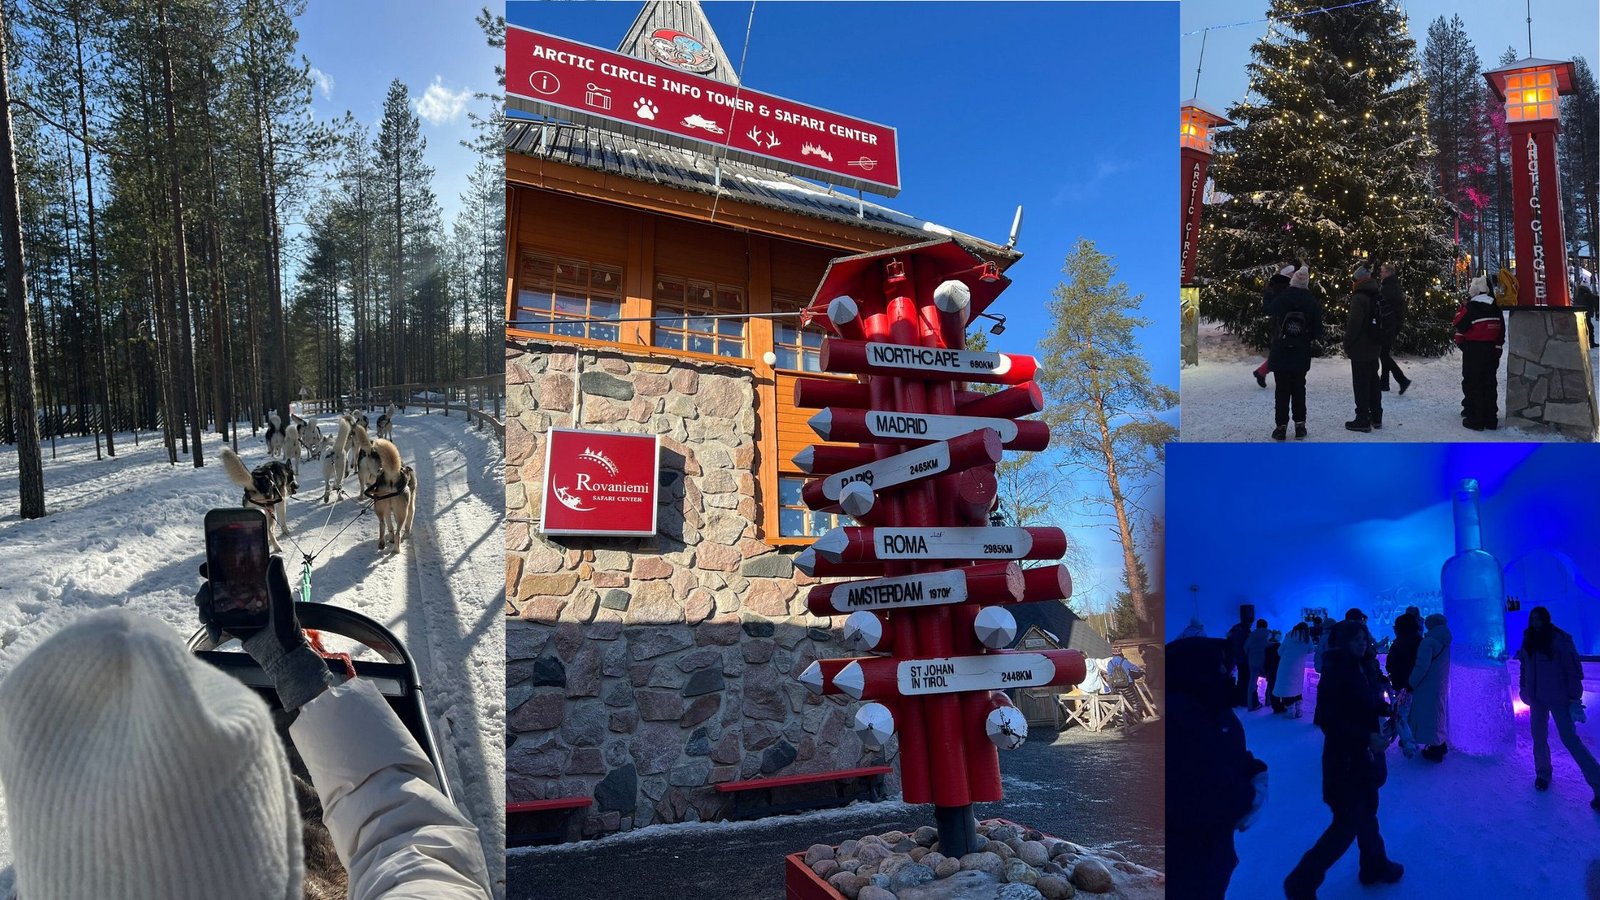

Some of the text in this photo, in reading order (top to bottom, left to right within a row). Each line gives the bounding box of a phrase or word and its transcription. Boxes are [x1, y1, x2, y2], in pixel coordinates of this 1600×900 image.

[533, 45, 878, 146] ARCTIC CIRCLE INFO TOWER & SAFARI CENTER
[1188, 162, 1200, 214] ARCTIC
[1180, 222, 1192, 277] CIRCLE
[1531, 220, 1546, 298] CIRCLE
[873, 346, 994, 370] NORTHCAPE 680KM
[876, 415, 928, 435] MADRID
[575, 473, 649, 493] Rovaniemi
[883, 535, 1013, 554] ROMA 2985KM
[848, 582, 923, 606] AMSTERDAM
[910, 663, 954, 677] ST JOHAN
[1001, 670, 1033, 683] 2448KM
[911, 676, 948, 689] IN TIROL
